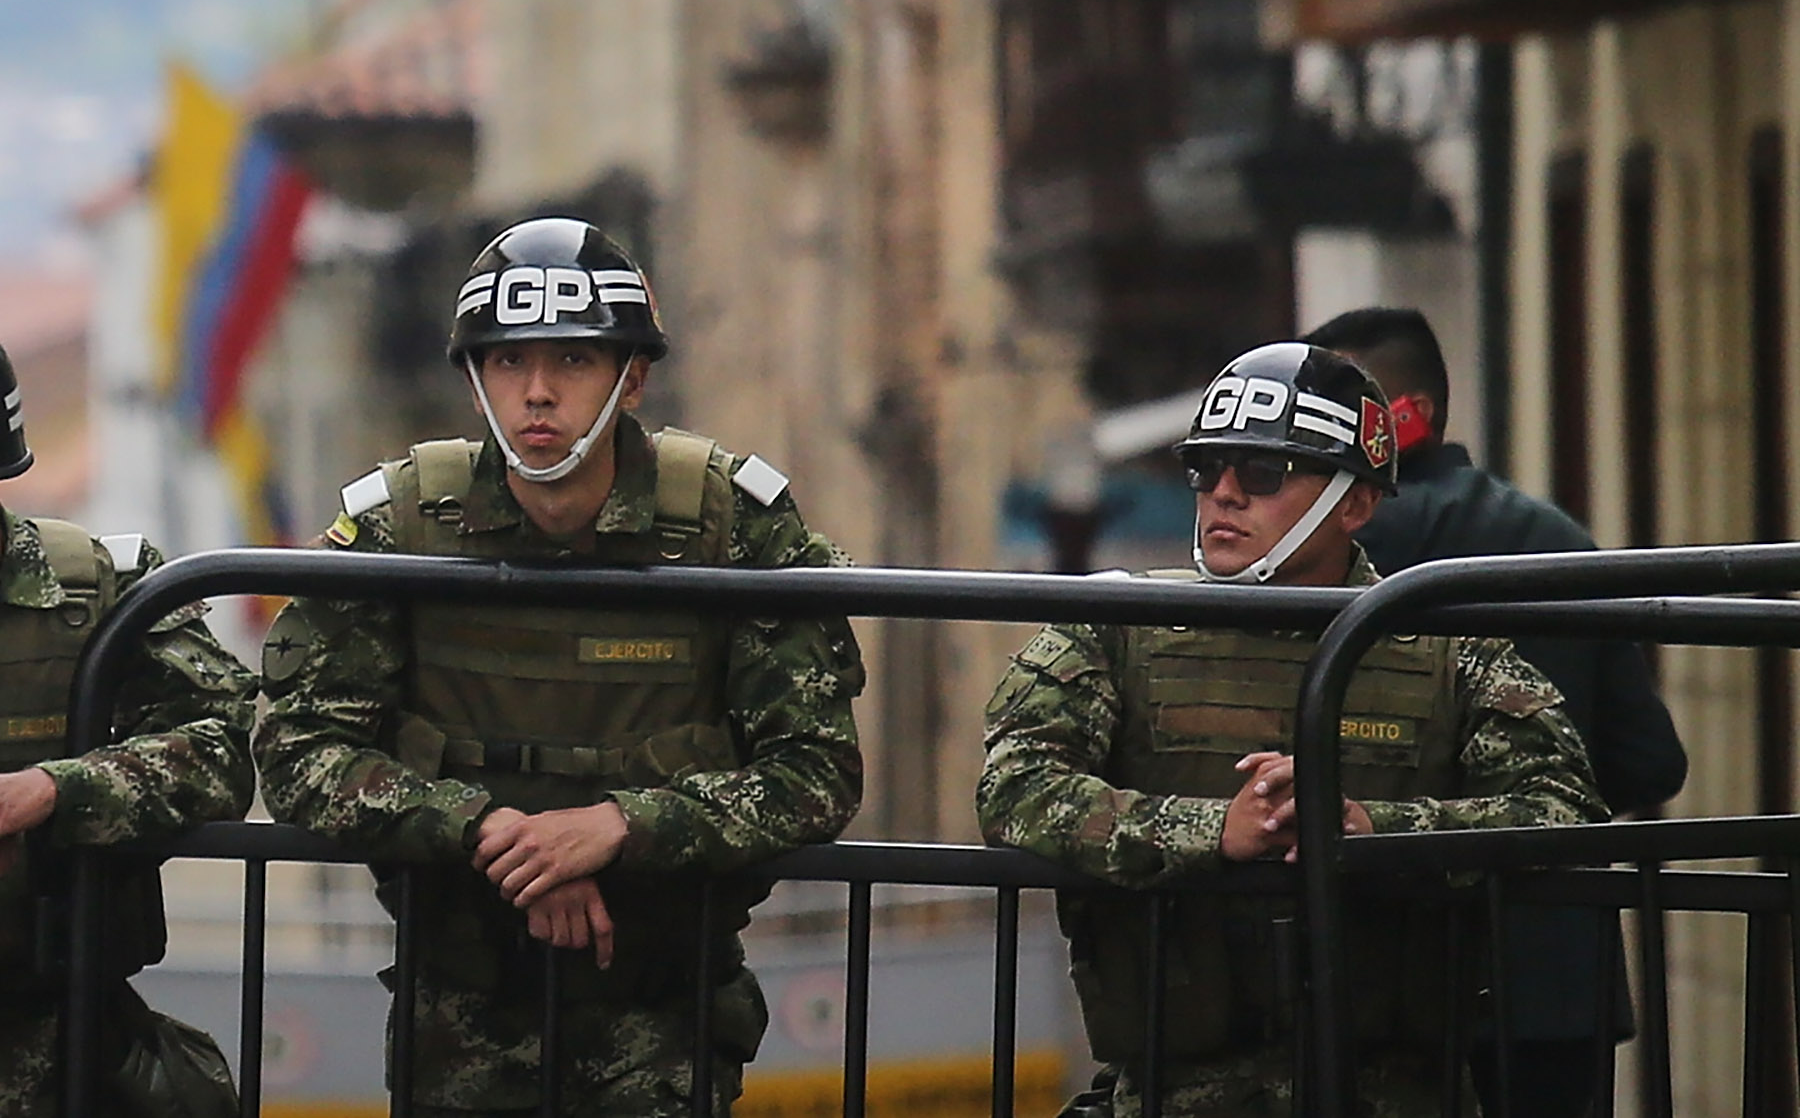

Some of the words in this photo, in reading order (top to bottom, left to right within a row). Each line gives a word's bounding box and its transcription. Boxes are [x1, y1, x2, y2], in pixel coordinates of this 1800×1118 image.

[496, 266, 594, 325] GP
[1200, 376, 1289, 431] GP
[594, 642, 675, 659] EJERCITO
